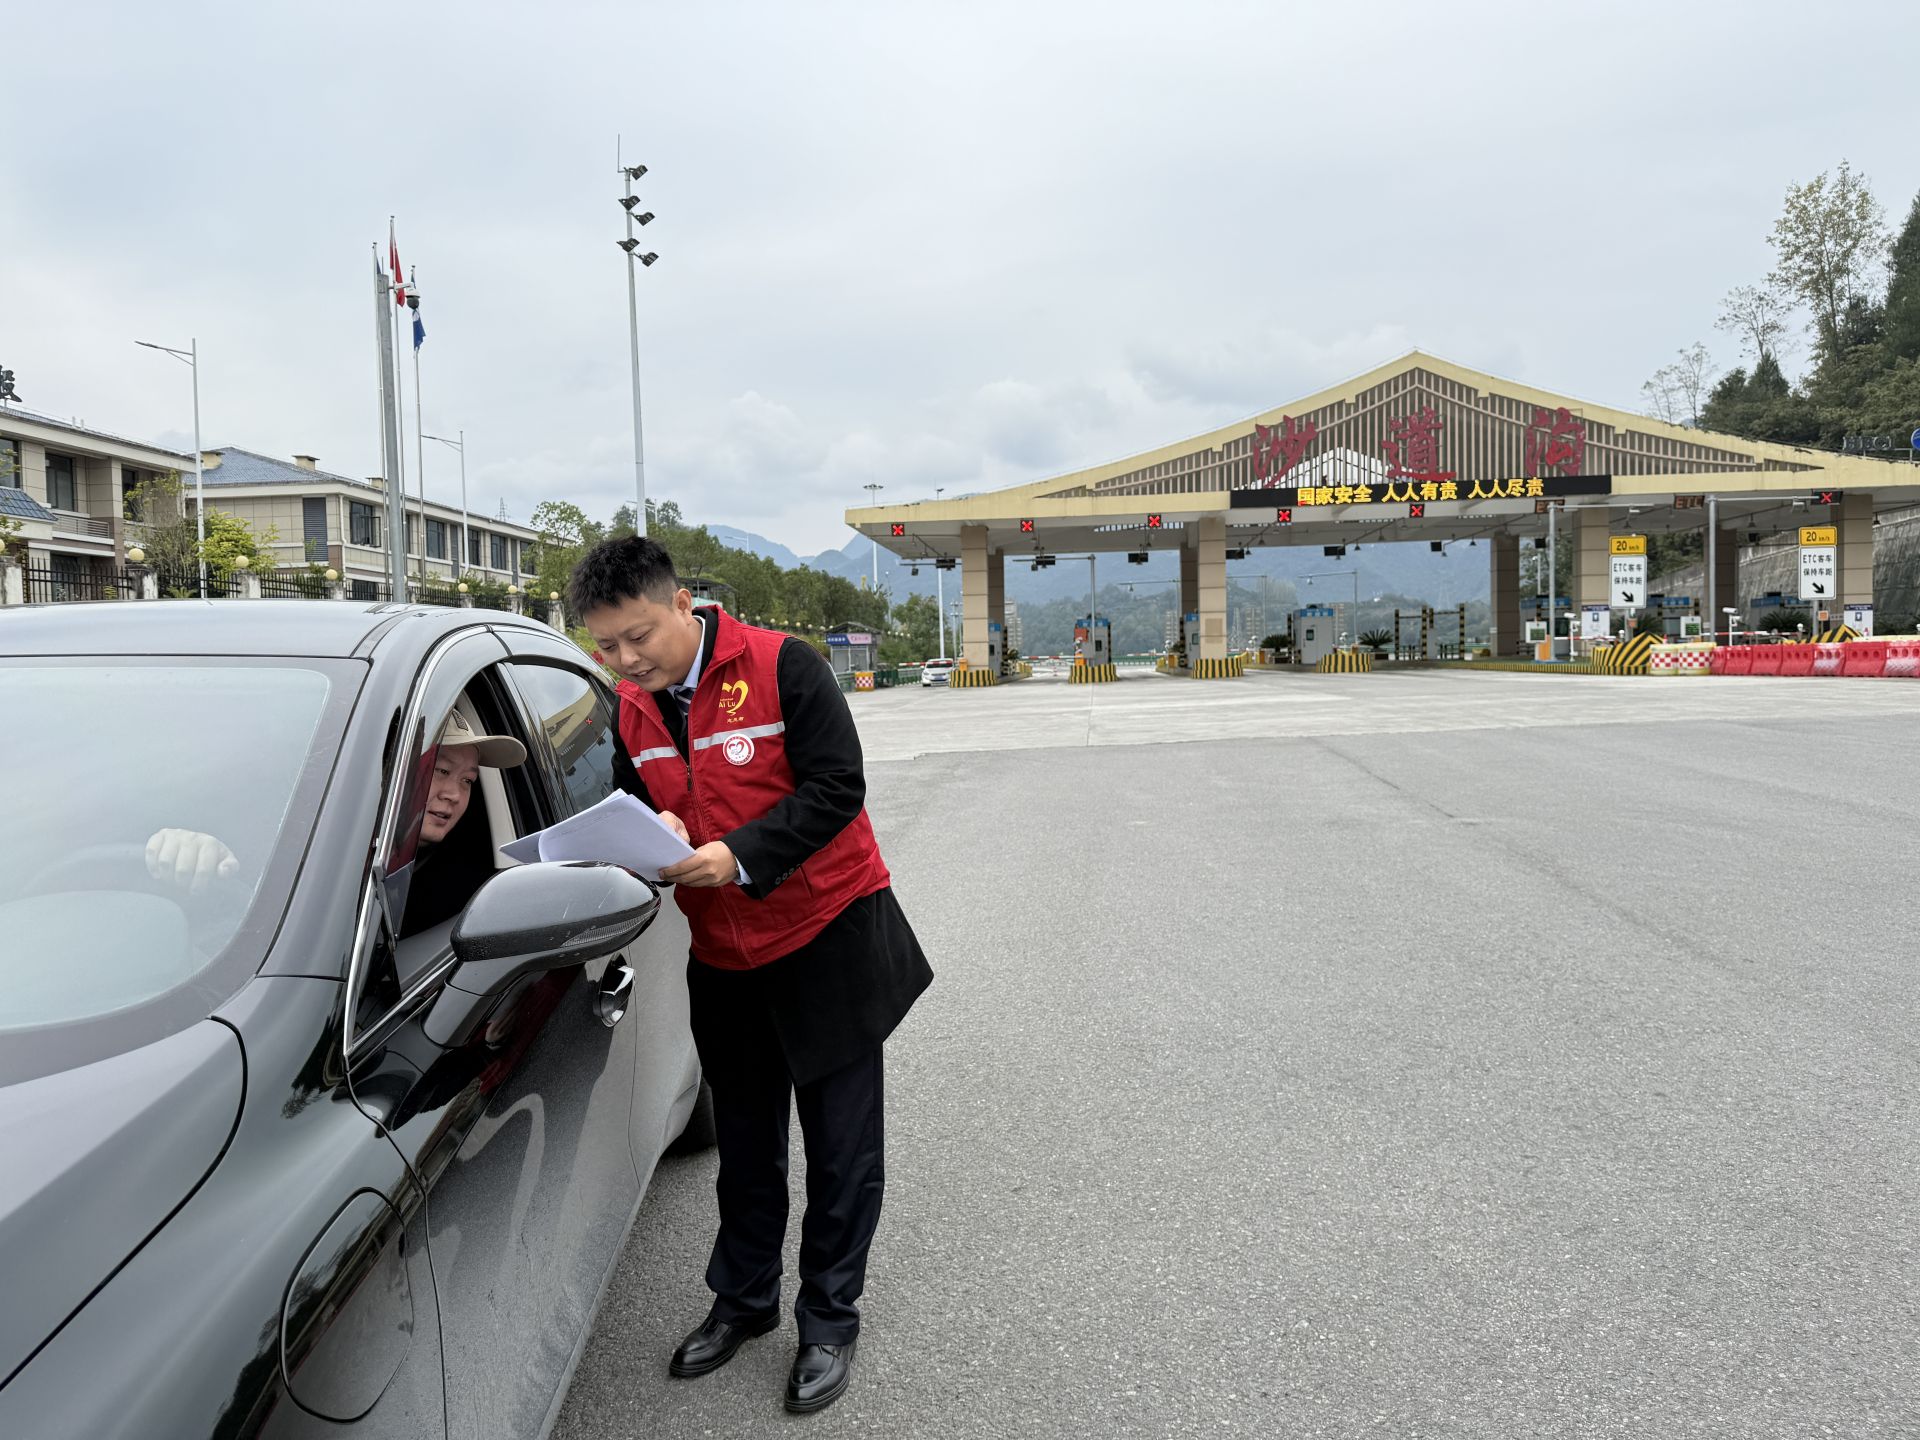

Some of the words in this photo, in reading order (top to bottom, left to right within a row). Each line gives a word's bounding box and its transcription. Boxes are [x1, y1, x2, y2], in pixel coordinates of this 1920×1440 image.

[1297, 484, 1373, 506] 国家安全
[1381, 480, 1458, 503] 人人有责
[1467, 477, 1544, 500] 人人尽责
[1806, 531, 1817, 542] 20
[1616, 540, 1628, 551] 20
